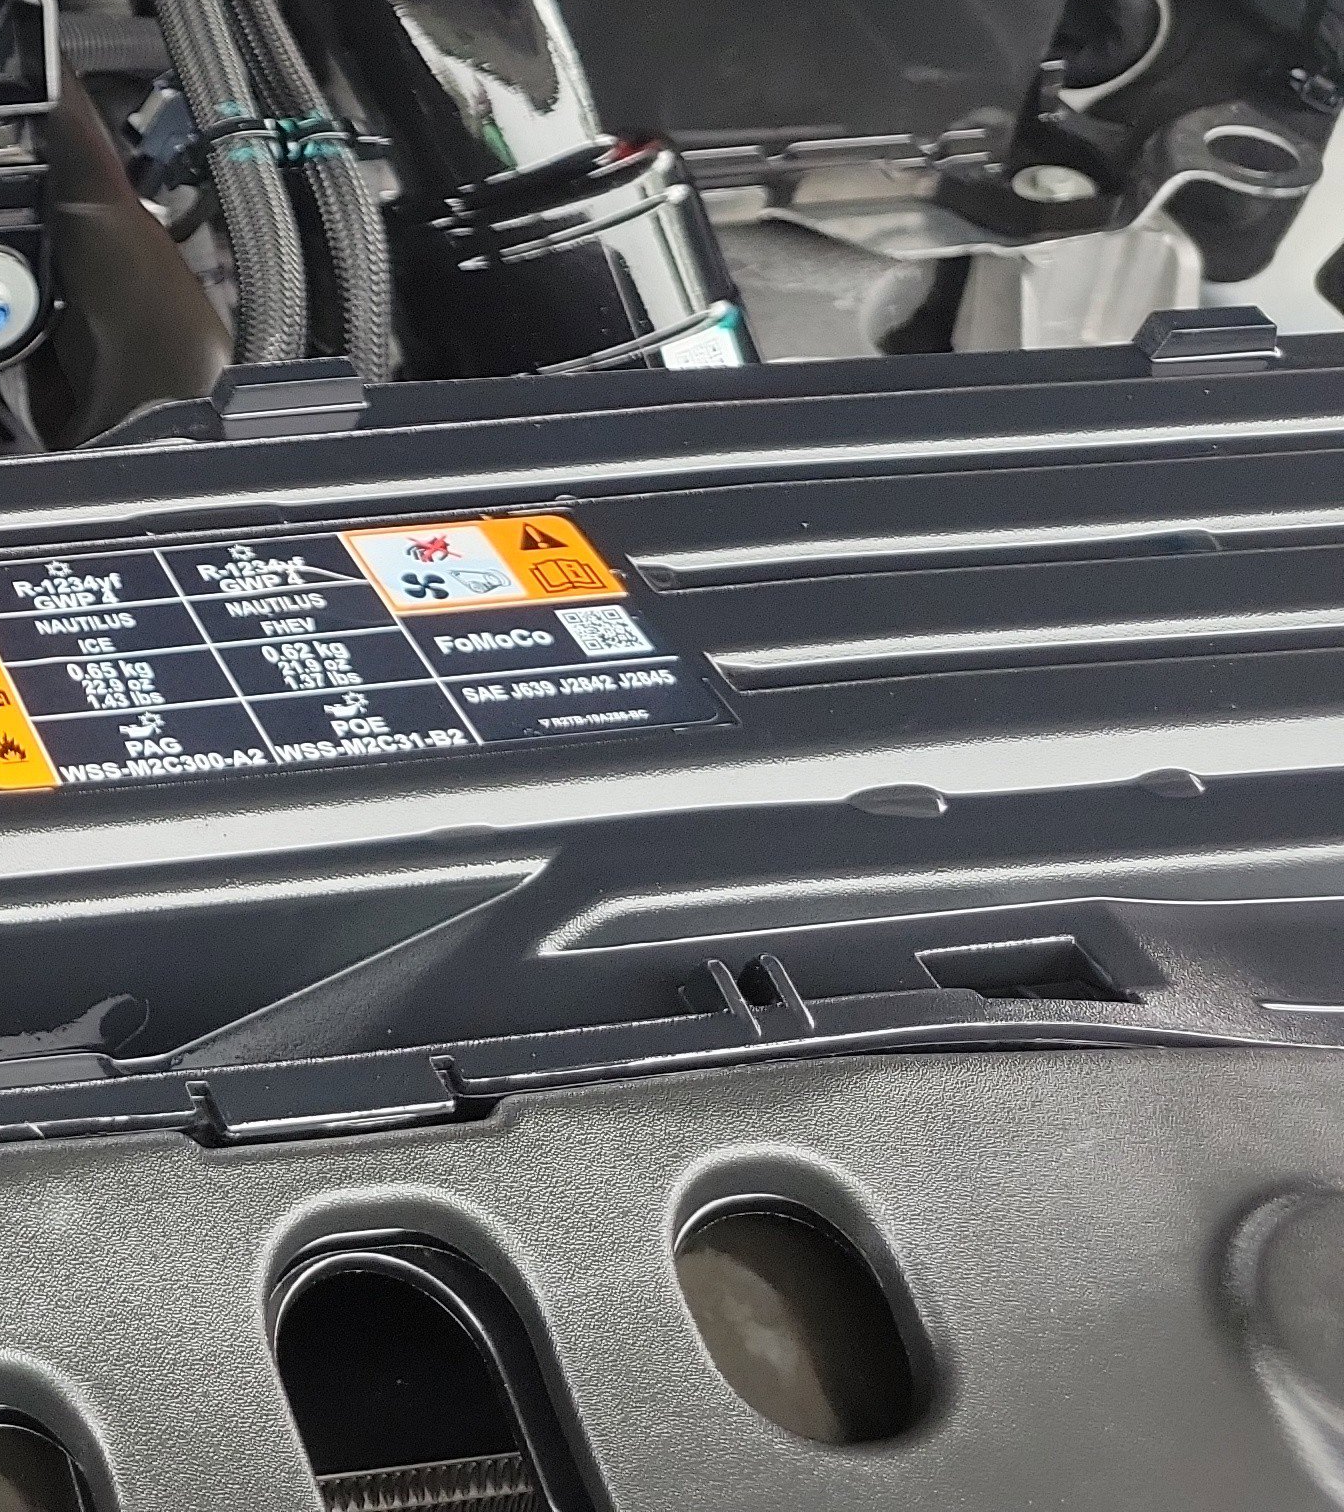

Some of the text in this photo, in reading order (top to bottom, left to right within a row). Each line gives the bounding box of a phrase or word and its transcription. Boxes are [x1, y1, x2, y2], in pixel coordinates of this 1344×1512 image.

[196, 555, 306, 582] R-1234yf
[12, 572, 123, 598] R-1234yf
[219, 569, 306, 593] GWP 4
[33, 588, 120, 610] GWP 4
[224, 592, 327, 618] NAUTILUS
[34, 612, 137, 635] NAUTILUS
[260, 616, 316, 637] FHEV
[78, 637, 116, 655] ICE
[262, 640, 351, 664] 0.62 kg
[433, 628, 555, 655] FoMoCo
[66, 659, 155, 682] 0.65 kg
[277, 658, 352, 676] 21.9 oz
[82, 677, 155, 695] 22.9 oz
[284, 670, 362, 690] 1.37 lbs
[462, 669, 677, 704] SAE J639 J2842 J2845
[86, 689, 165, 710] 1.43 lbs
[330, 716, 390, 737] POE
[125, 737, 183, 758] PAG
[274, 728, 469, 763] WSS-M2C31-B2
[59, 748, 268, 783] WSS-M2C300-A2
